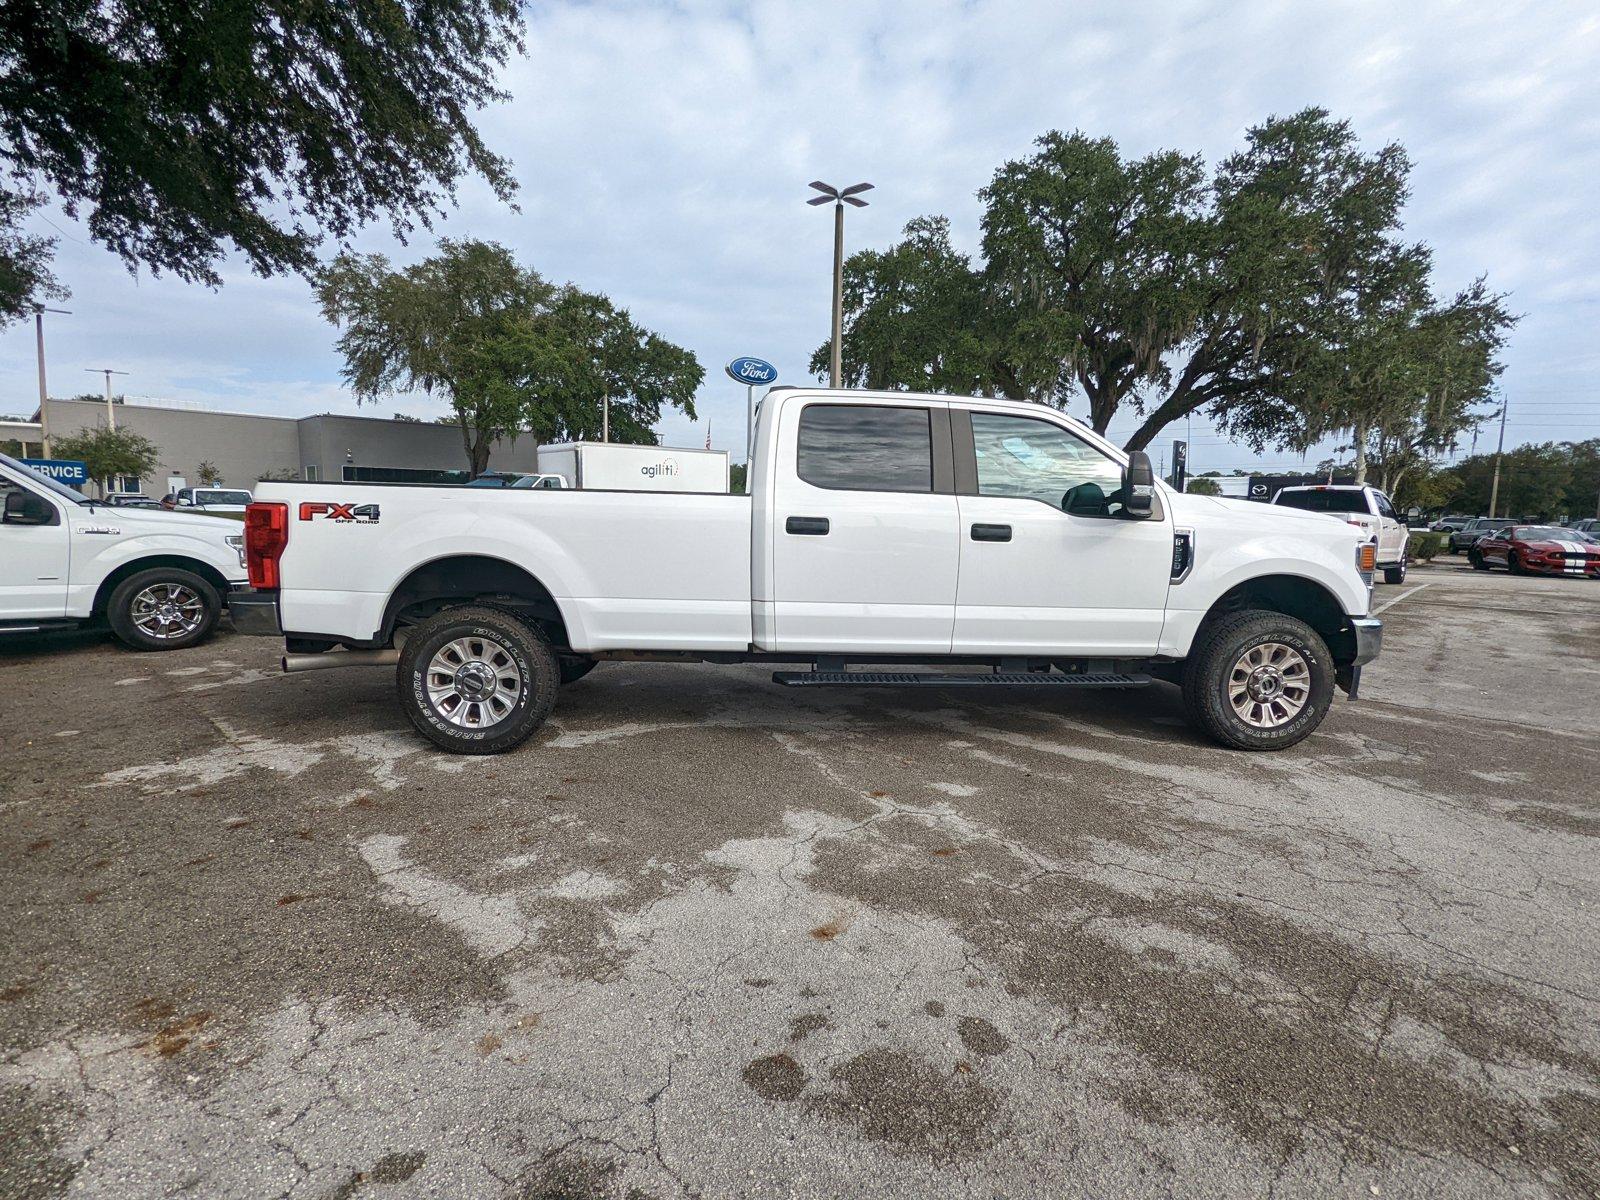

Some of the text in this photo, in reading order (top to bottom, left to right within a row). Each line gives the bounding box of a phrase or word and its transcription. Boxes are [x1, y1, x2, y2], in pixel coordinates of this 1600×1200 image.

[740, 361, 769, 379] Ford
[31, 464, 83, 478] ERVICE
[641, 464, 673, 478] agiliti
[299, 501, 381, 521] FX4
